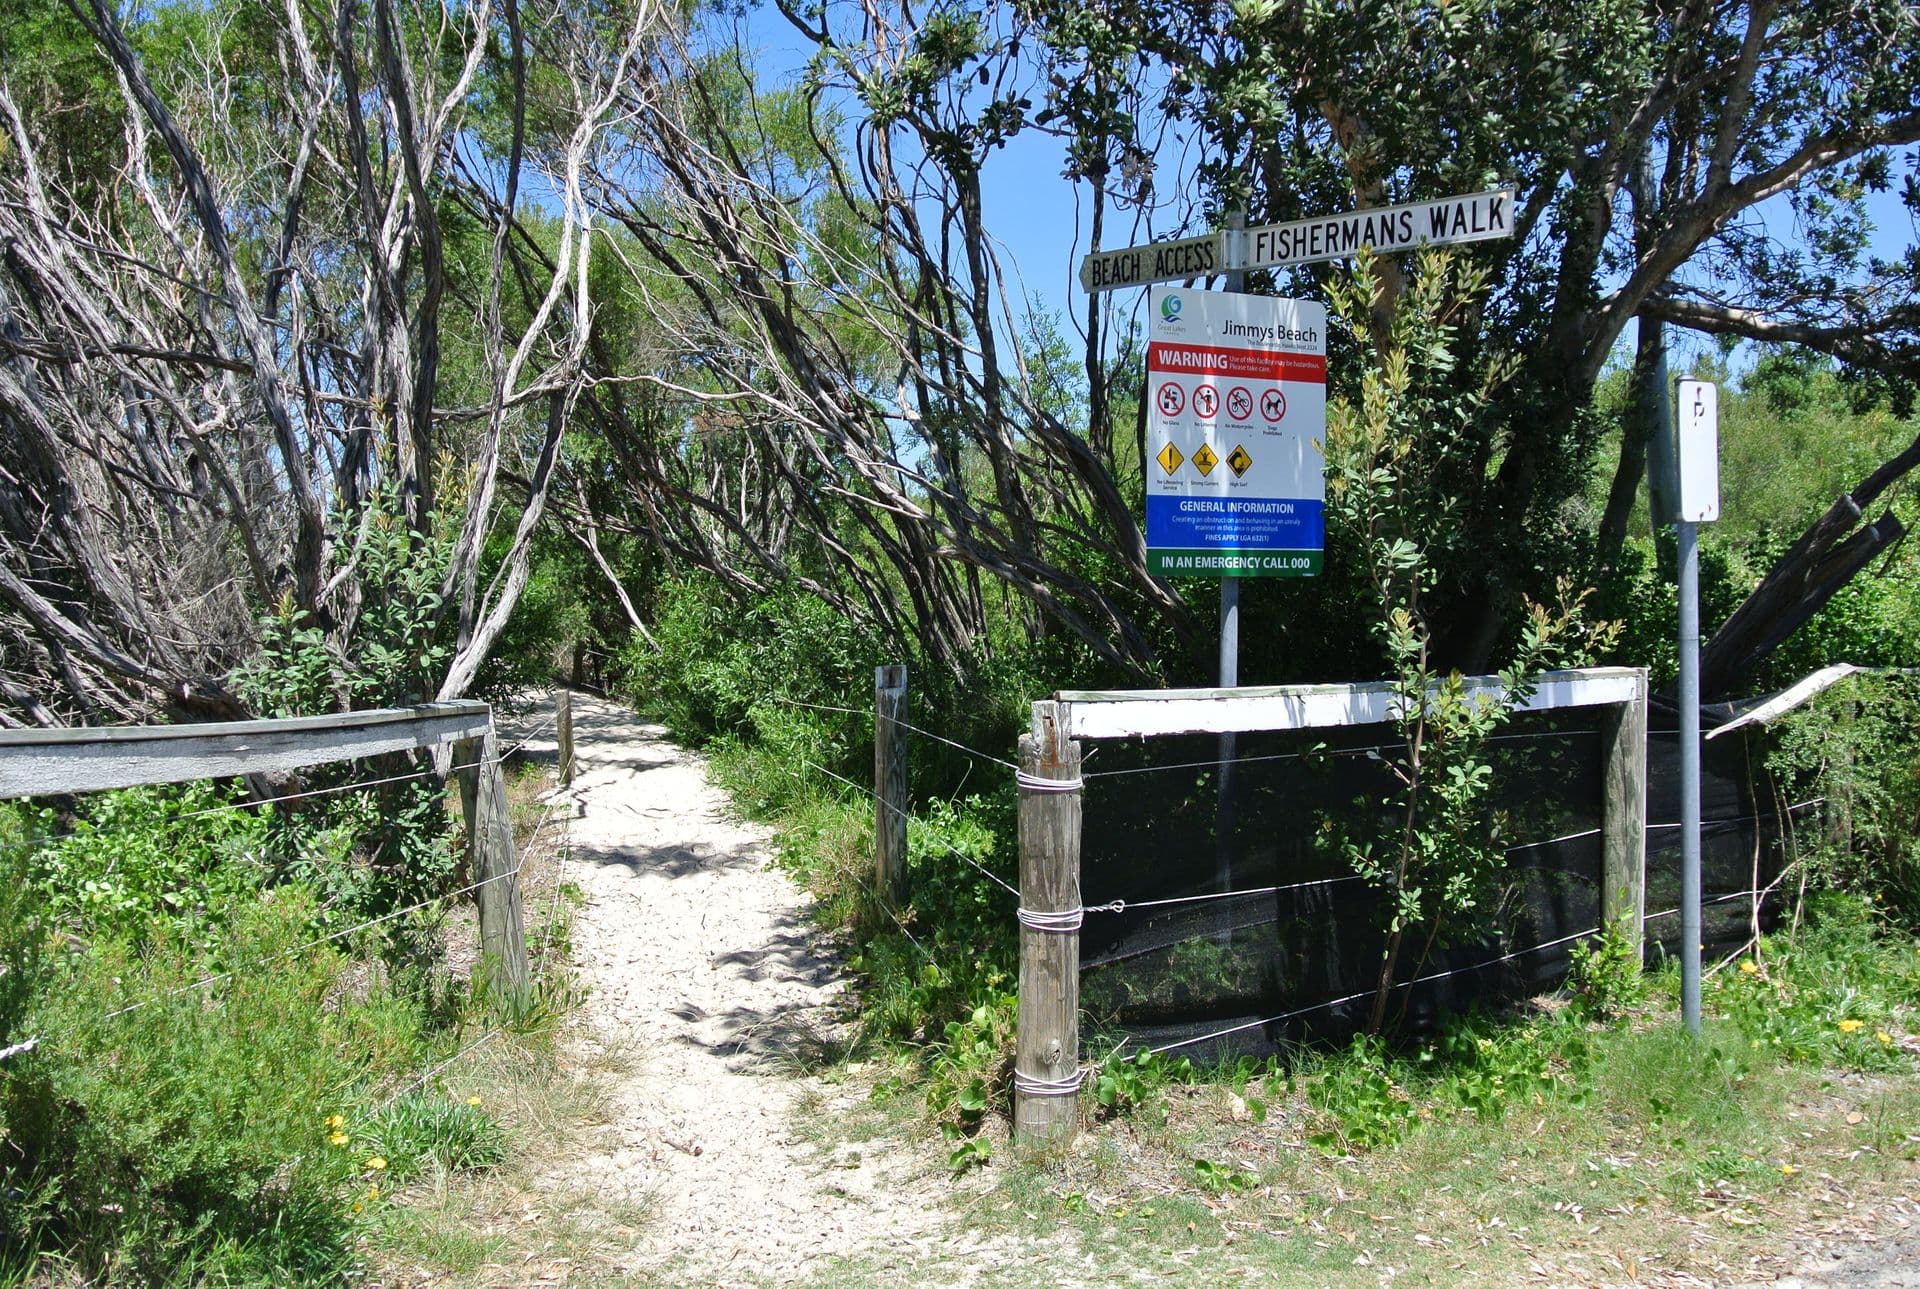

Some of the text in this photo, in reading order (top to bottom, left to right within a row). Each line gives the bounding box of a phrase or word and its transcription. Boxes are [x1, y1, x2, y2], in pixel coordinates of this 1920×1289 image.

[1257, 197, 1505, 263] FISHERMANS WALK
[1092, 240, 1214, 287] BEACH ACCESS
[1222, 319, 1318, 343] Jimmys Beach
[1158, 350, 1228, 370] WARNING
[1229, 362, 1246, 370] Please
[1246, 356, 1256, 364] this
[1257, 357, 1274, 366] facility
[1274, 359, 1286, 368] may
[1180, 500, 1294, 514] GENERAL INFORMATION
[1172, 515, 1196, 525] Creating
[1204, 516, 1235, 524] obstruction
[1246, 518, 1270, 527] behaving
[1284, 518, 1301, 527] unruly
[1222, 534, 1239, 542] APPLY
[1240, 534, 1251, 542] LGA
[1252, 535, 1270, 543] 632(1)
[1162, 556, 1311, 569] IN AN EMERGENCY CALL 000
